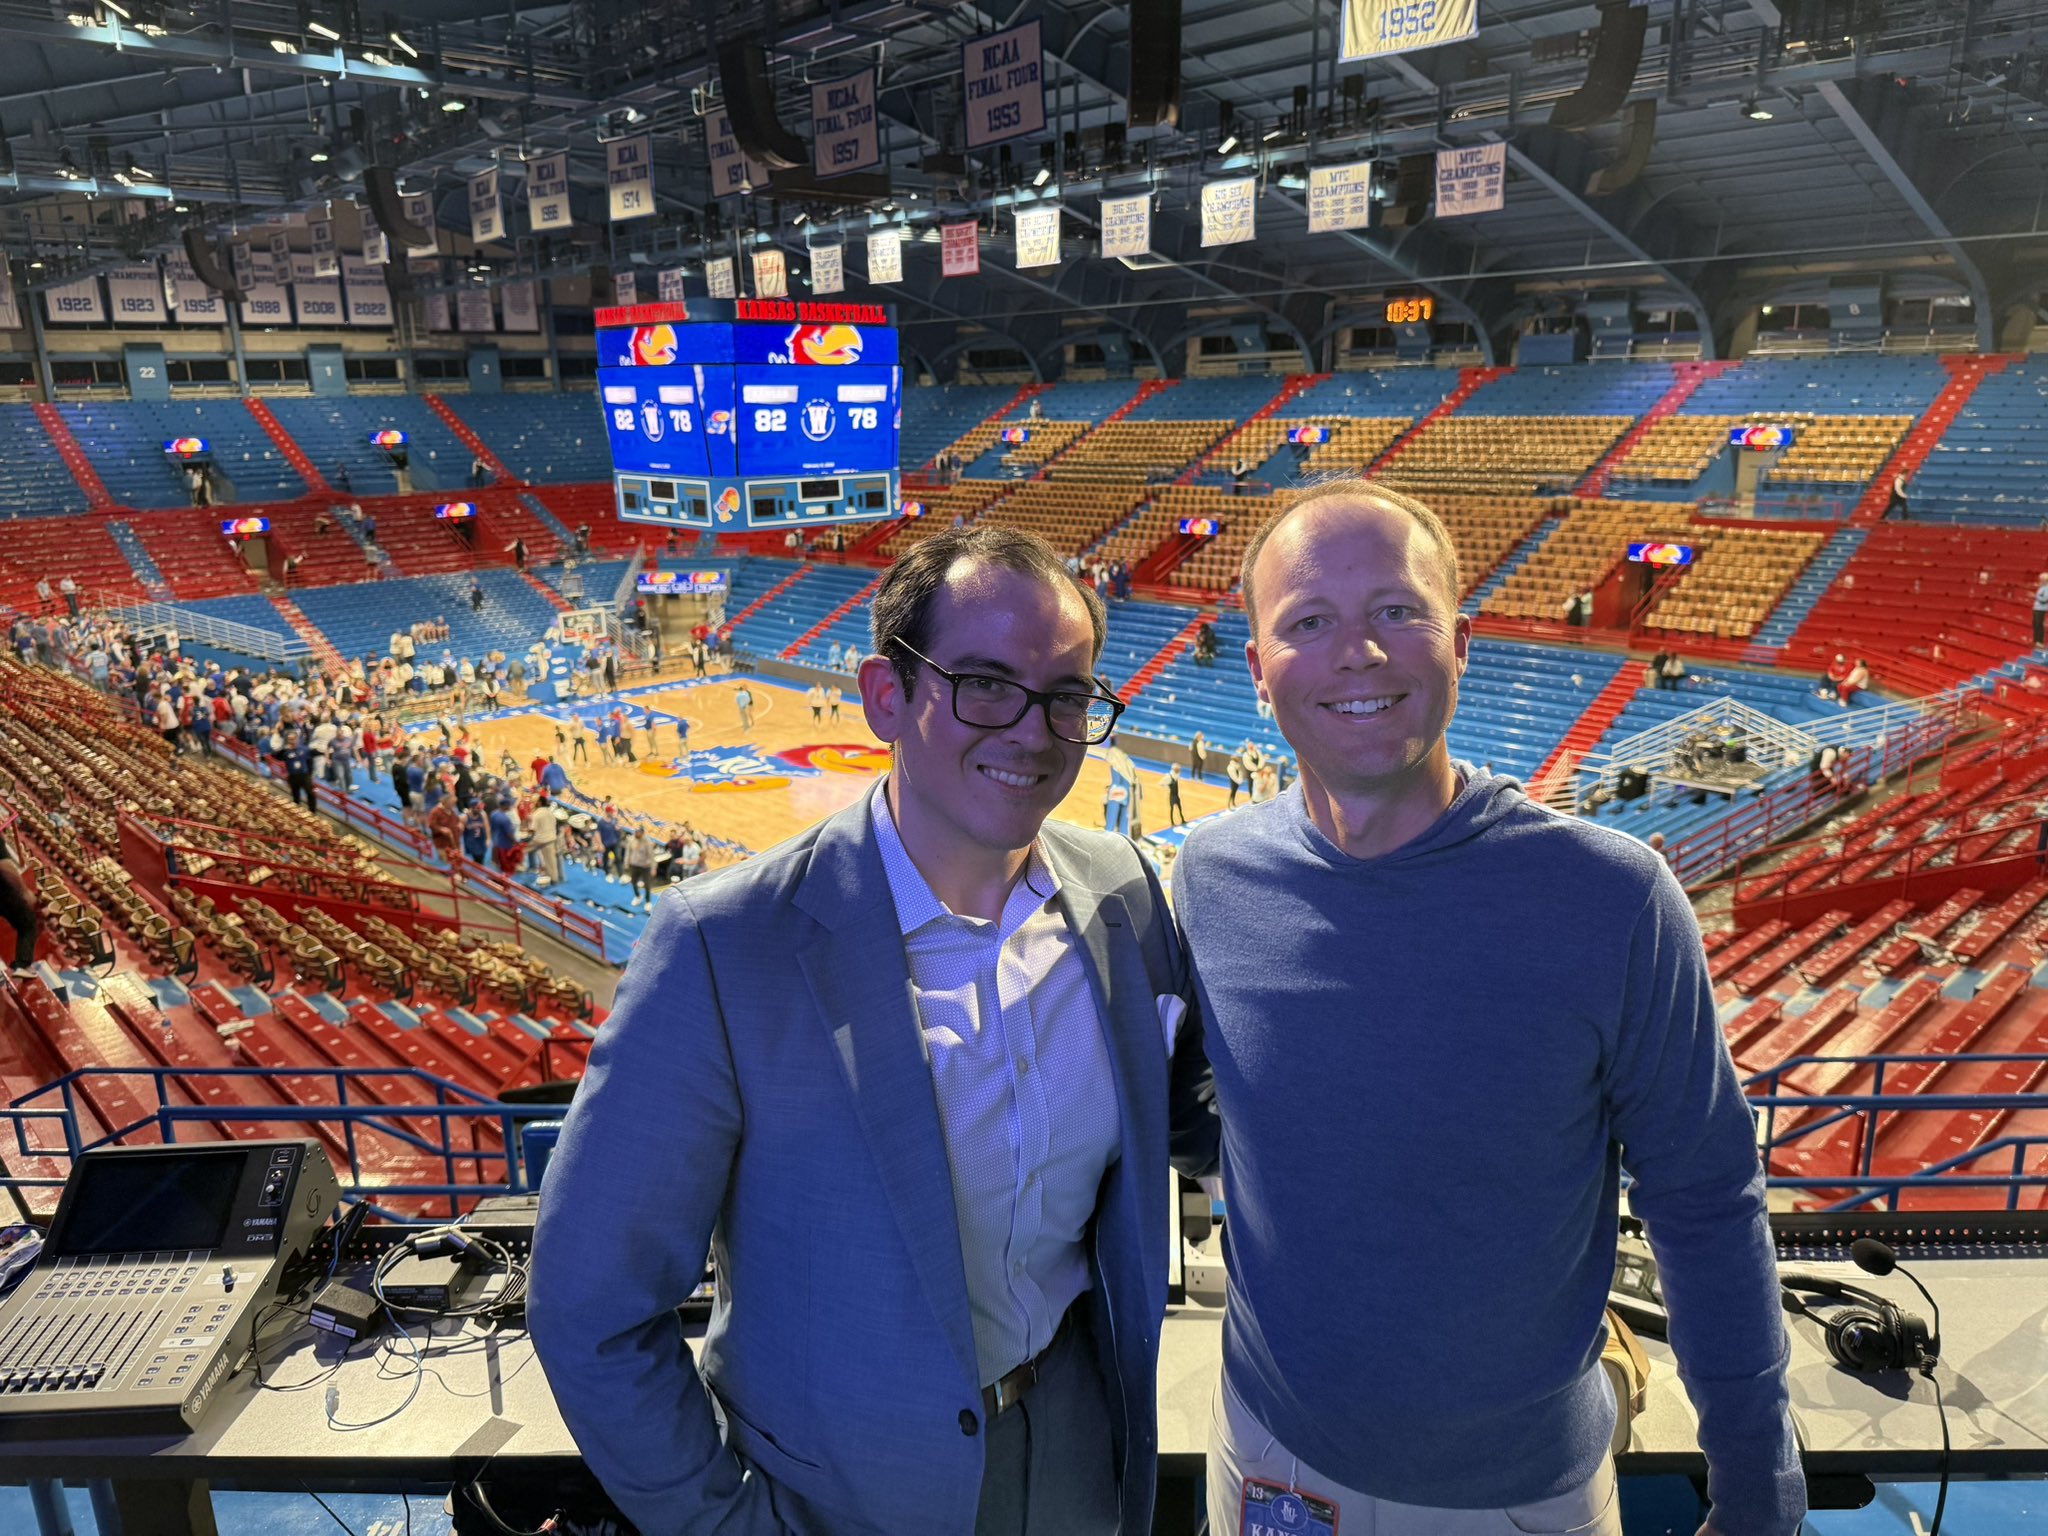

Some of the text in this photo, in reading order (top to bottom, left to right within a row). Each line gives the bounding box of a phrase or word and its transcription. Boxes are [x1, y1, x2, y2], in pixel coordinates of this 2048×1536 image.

[1380, 1, 1436, 39] 1952
[982, 38, 1020, 72] NCAA
[968, 62, 1038, 100] FINAL FOUR
[827, 83, 859, 111] NCAA
[815, 104, 873, 135] FINAL FOUR
[987, 101, 1021, 132] 1953
[833, 138, 859, 165] 1957
[1458, 150, 1483, 165] MVC
[1329, 170, 1350, 183] MVC
[1439, 162, 1501, 181] CHAMPIONS
[1312, 181, 1365, 199] CHAMPIONS
[56, 297, 93, 312] 1922
[121, 298, 155, 312] 1923
[184, 299, 216, 313] 1952
[303, 301, 336, 315] 2008
[354, 302, 387, 316] 2022
[736, 300, 888, 324] KANSAS BASKETBALL
[1386, 298, 1432, 323] 10:37
[139, 367, 157, 379] 22
[614, 408, 635, 431] 82
[669, 408, 692, 432] 78
[755, 408, 787, 432] 82
[848, 407, 877, 430] 78
[251, 1217, 278, 1226] YAMAHA
[199, 1353, 230, 1400] YAMAHA
[1251, 1486, 1264, 1500] 13
